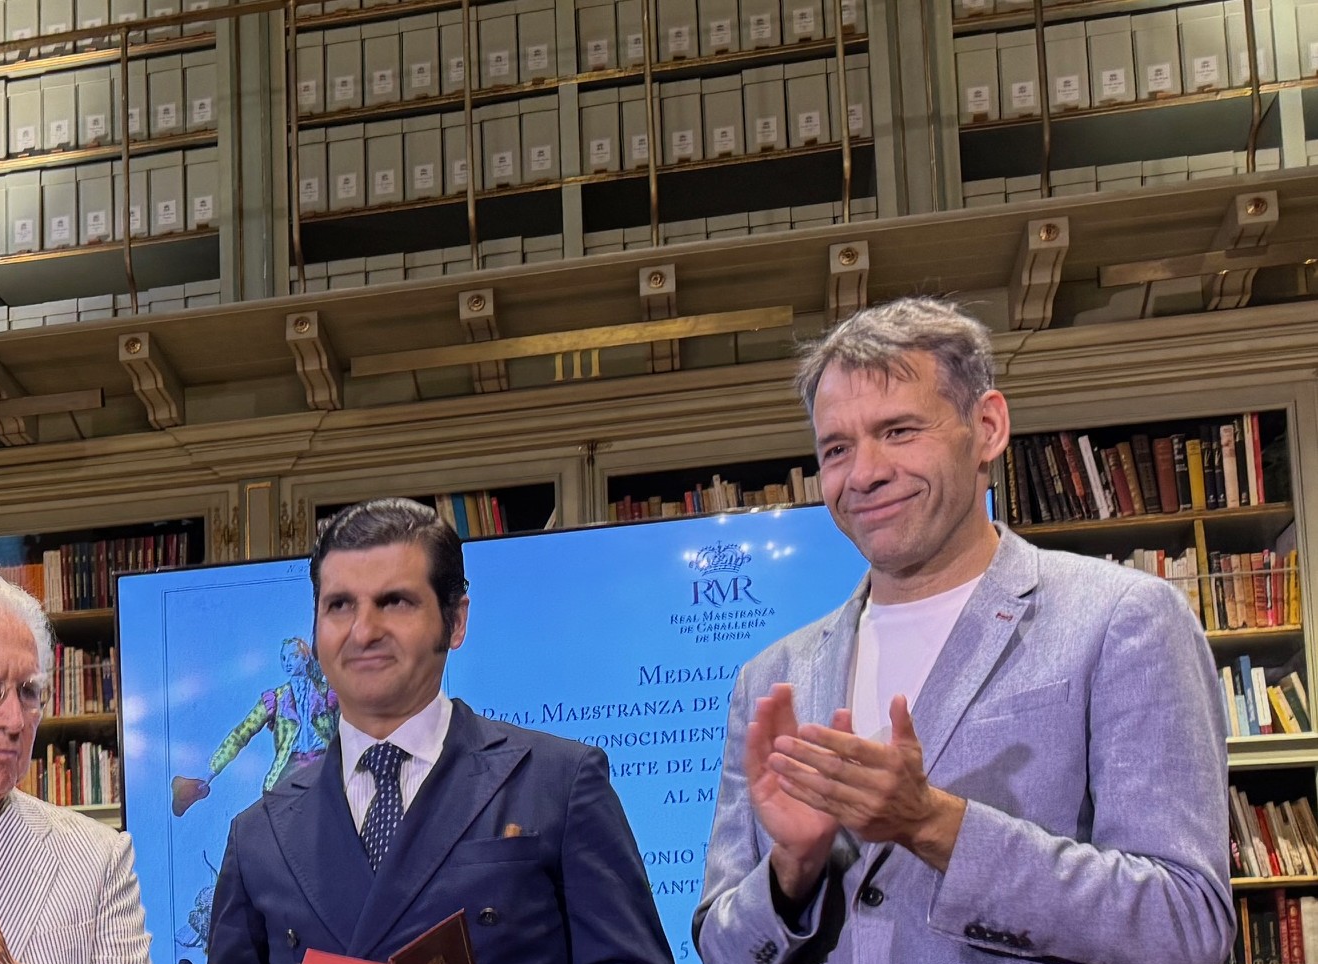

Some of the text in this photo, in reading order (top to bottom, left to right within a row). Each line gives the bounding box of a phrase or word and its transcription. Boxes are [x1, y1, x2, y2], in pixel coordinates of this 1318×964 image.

[670, 607, 776, 625] REAL MAESTRANZA
[680, 626, 694, 635] DE
[695, 630, 751, 644] DE RONDA
[541, 699, 684, 725] MAESTRANZA
[693, 695, 720, 712] DE
[577, 727, 726, 749] CONOCIMIENT
[667, 757, 694, 774] DE
[663, 788, 690, 805] AL
[643, 849, 694, 866] ONIO
